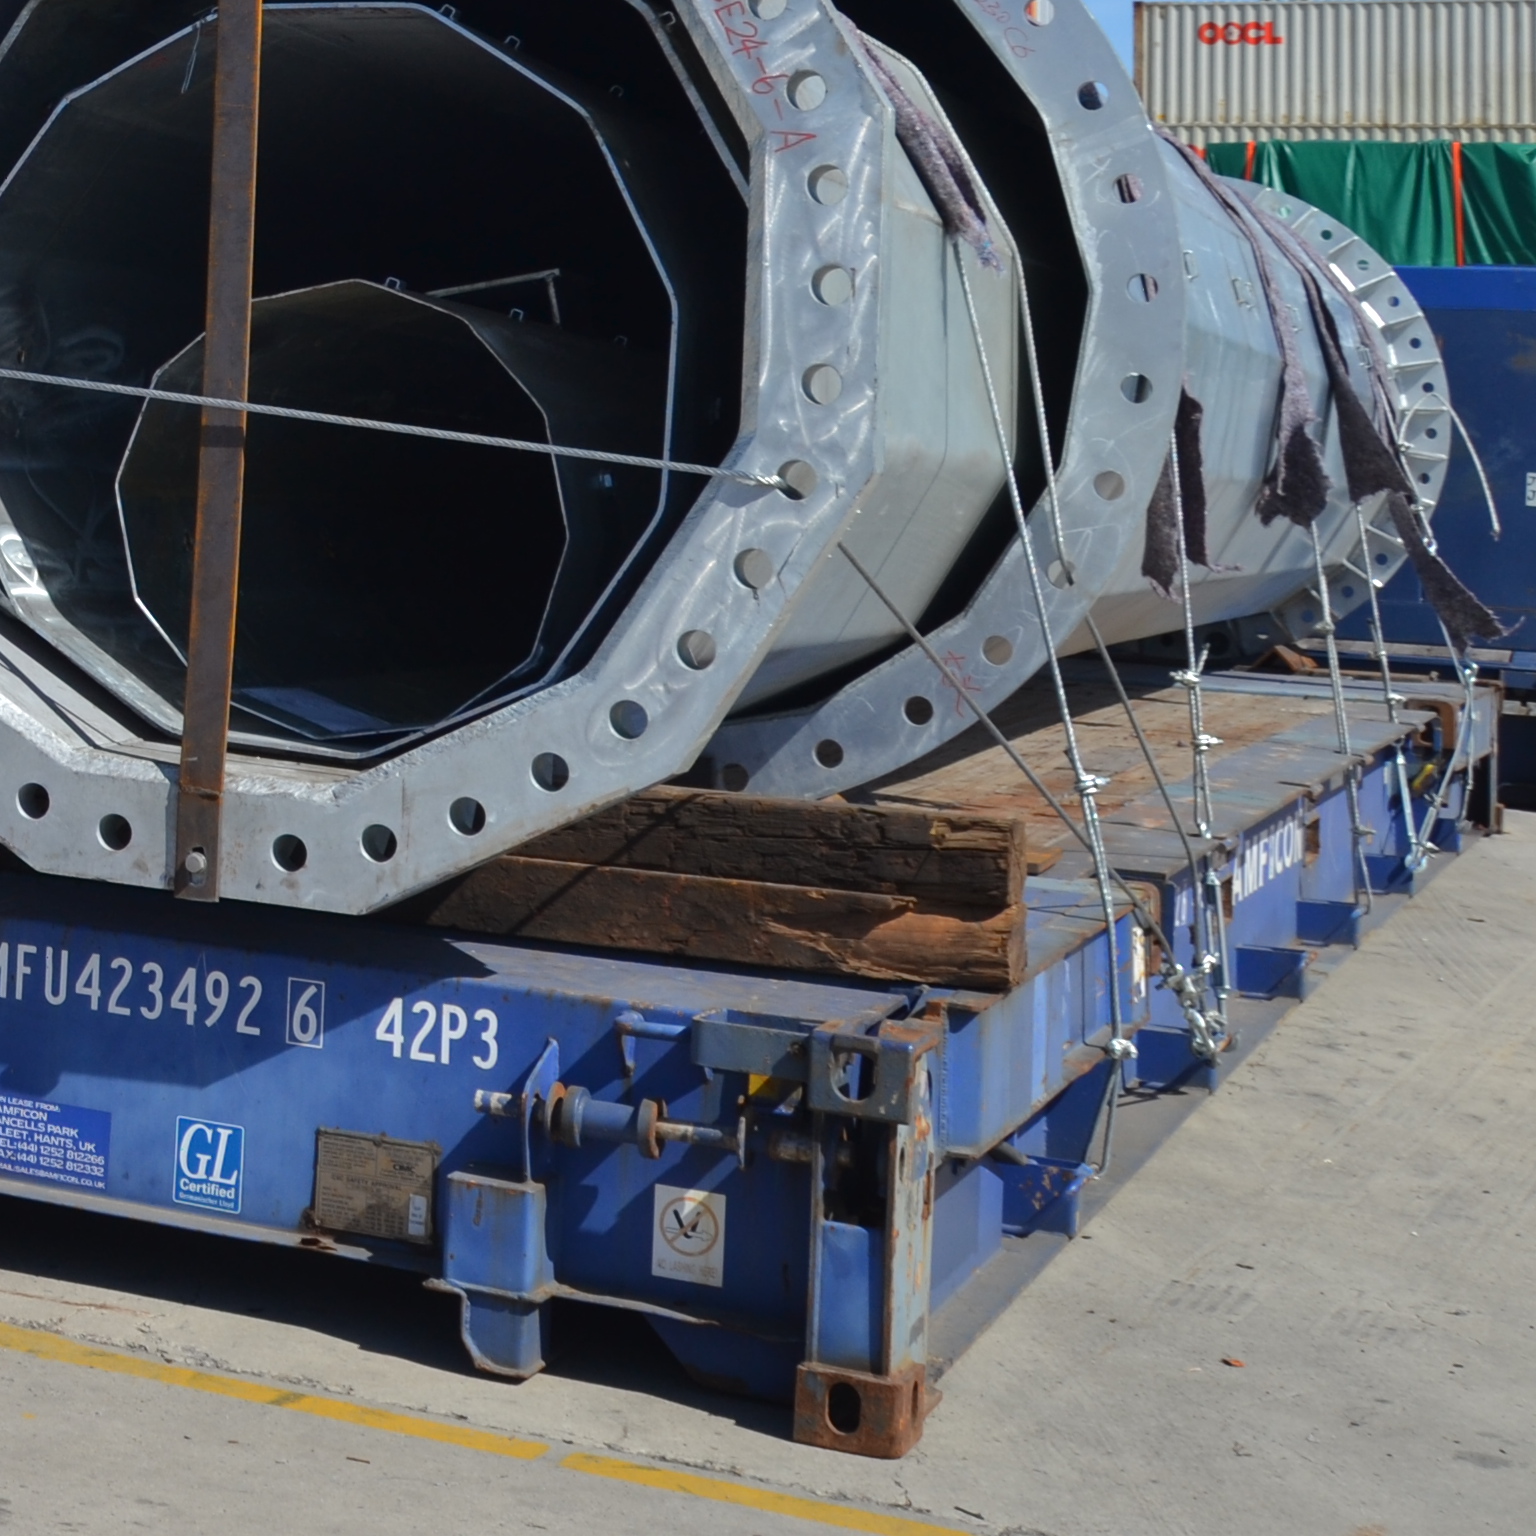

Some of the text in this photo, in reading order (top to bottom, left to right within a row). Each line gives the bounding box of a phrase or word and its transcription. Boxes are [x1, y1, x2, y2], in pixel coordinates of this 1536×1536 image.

[1197, 20, 1283, 45] OOCL
[1231, 810, 1304, 906] AMFICON
[291, 985, 318, 1043] 6
[374, 997, 500, 1070] 42P3
[7, 1097, 34, 1108] LEASE
[47, 1124, 79, 1138] PARK
[34, 1133, 76, 1150] HANTS,
[78, 1141, 96, 1152] UK
[39, 1145, 65, 1158] 1252
[66, 1150, 105, 1165] 812266
[179, 1123, 238, 1186] GL
[39, 1156, 64, 1169] 1252
[65, 1161, 104, 1177] 812332
[180, 1177, 235, 1199] Certified
